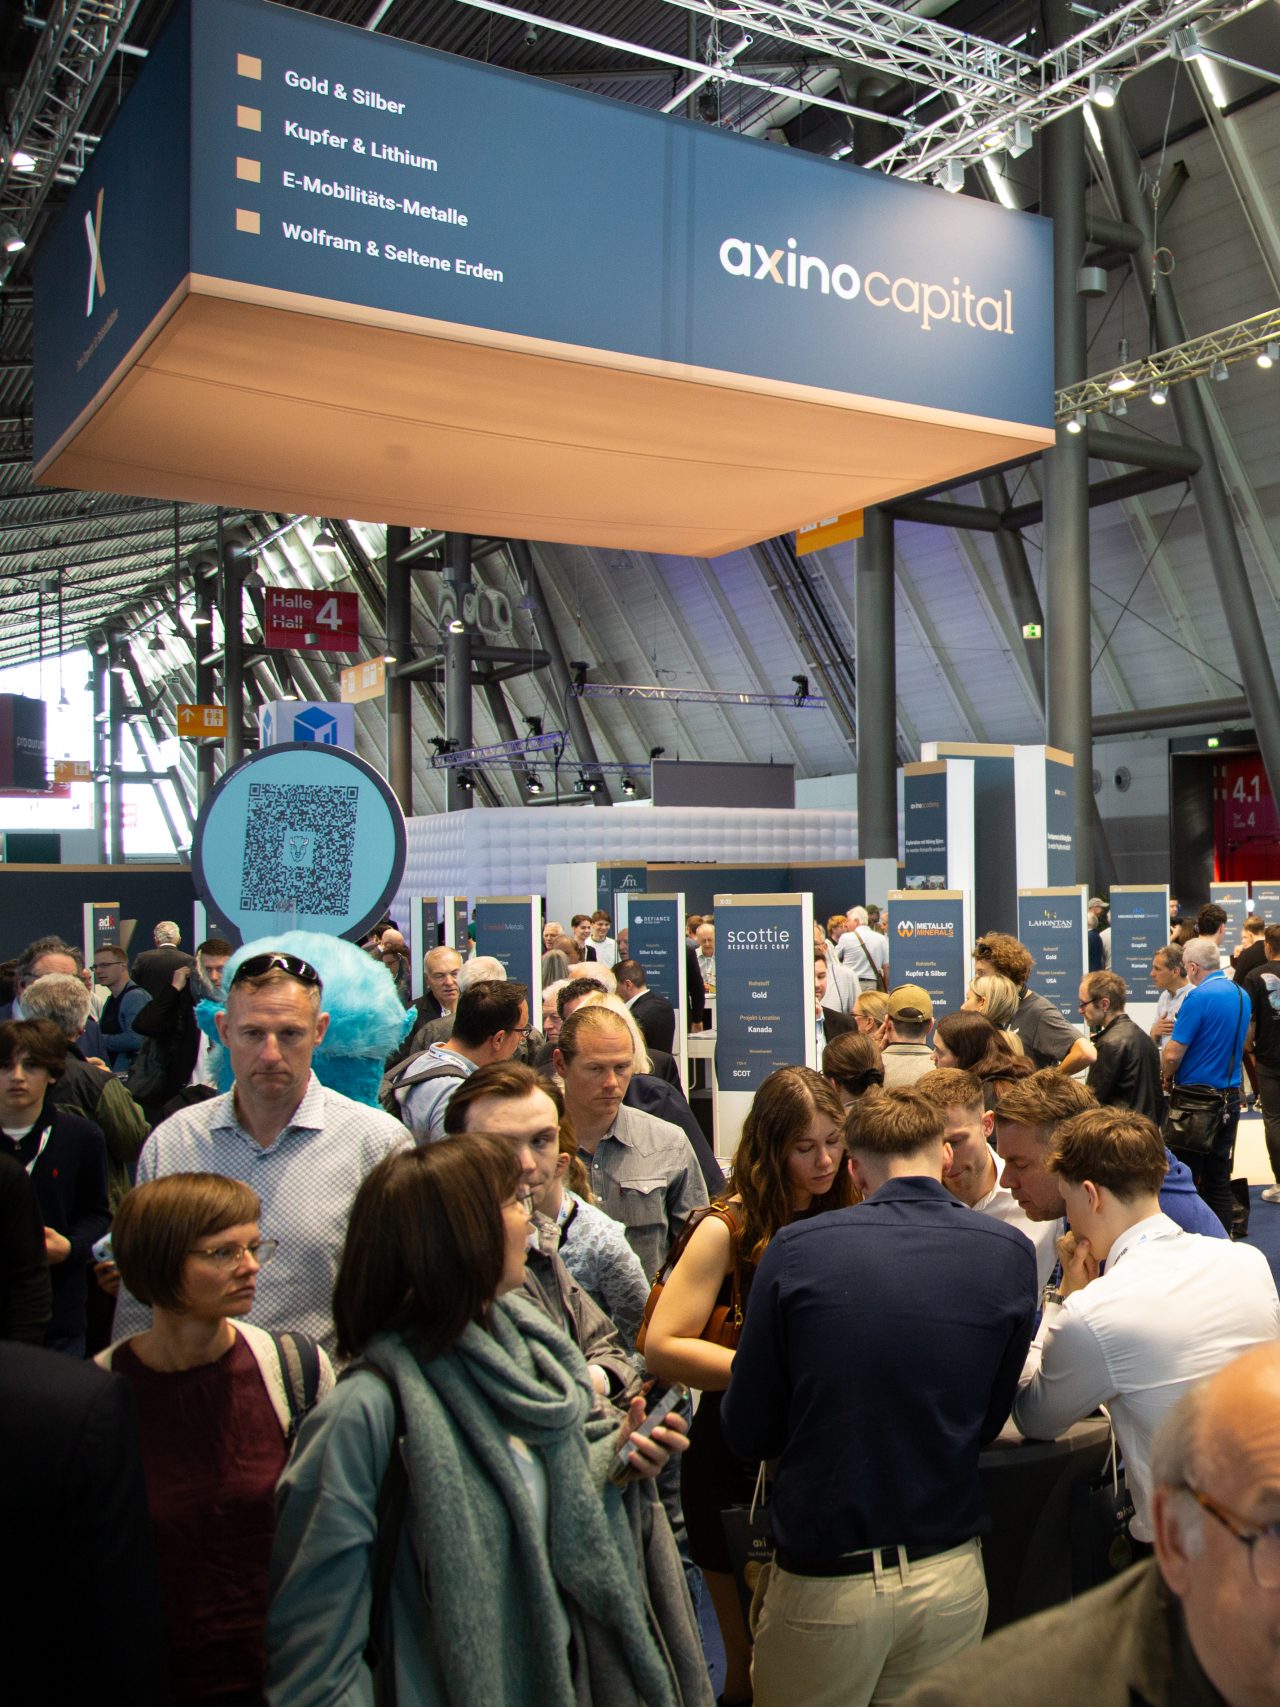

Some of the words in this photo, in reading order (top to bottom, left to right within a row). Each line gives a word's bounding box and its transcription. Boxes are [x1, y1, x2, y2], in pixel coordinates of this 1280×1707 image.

[285, 70, 329, 95] Gold
[334, 83, 348, 100] &
[353, 88, 405, 114] Silber
[285, 120, 348, 149] Kupfer
[352, 137, 366, 154] &
[371, 142, 438, 171] Lithium
[283, 171, 468, 226] E-Mobilitäts-Metalle
[282, 222, 361, 253] Wolfram
[366, 240, 380, 257] &
[385, 244, 451, 272] Seltene
[455, 258, 504, 283] Erden
[719, 237, 1014, 335] axinocapital
[272, 593, 312, 609] Halle
[316, 597, 343, 630] 4
[272, 614, 303, 629] Hall
[1233, 775, 1260, 802] 4.1
[1248, 811, 1256, 828] 4
[727, 925, 790, 943] scottie
[751, 991, 768, 1000] Gold
